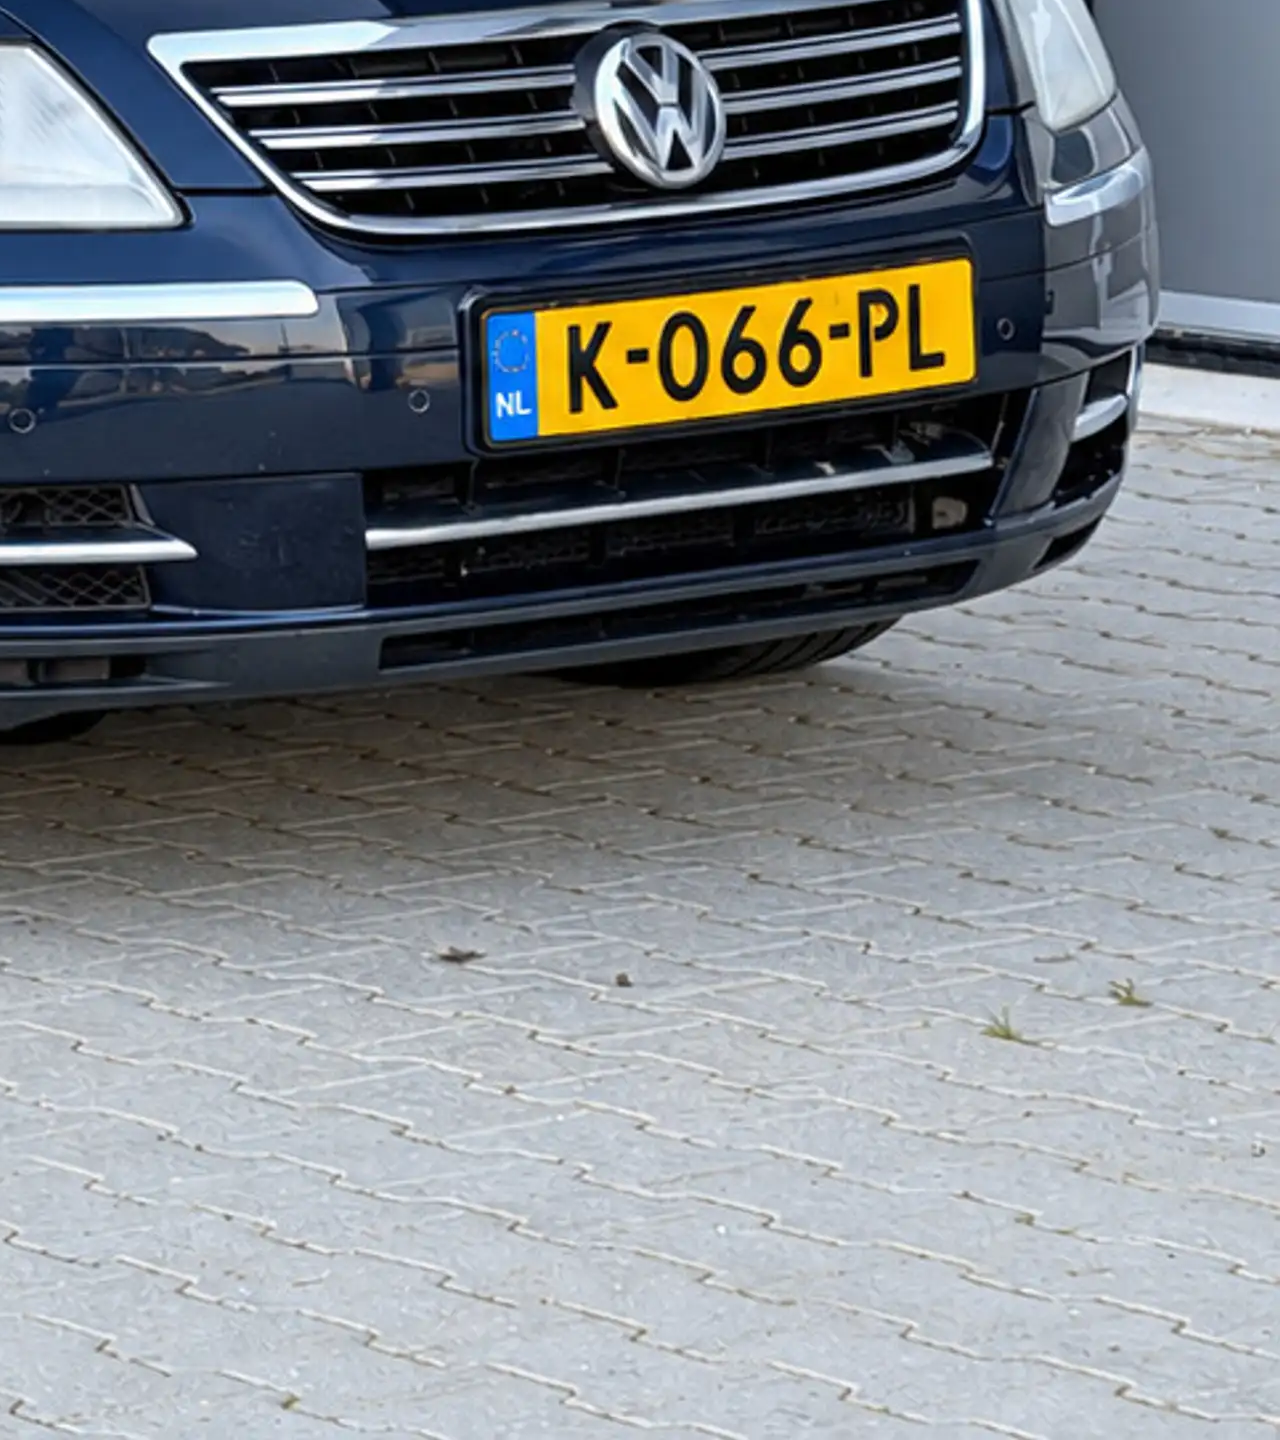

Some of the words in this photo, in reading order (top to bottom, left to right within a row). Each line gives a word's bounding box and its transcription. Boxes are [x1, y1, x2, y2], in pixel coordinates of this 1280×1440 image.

[597, 35, 725, 186] VW
[495, 389, 532, 419] NL
[566, 283, 946, 415] K-066-PL
